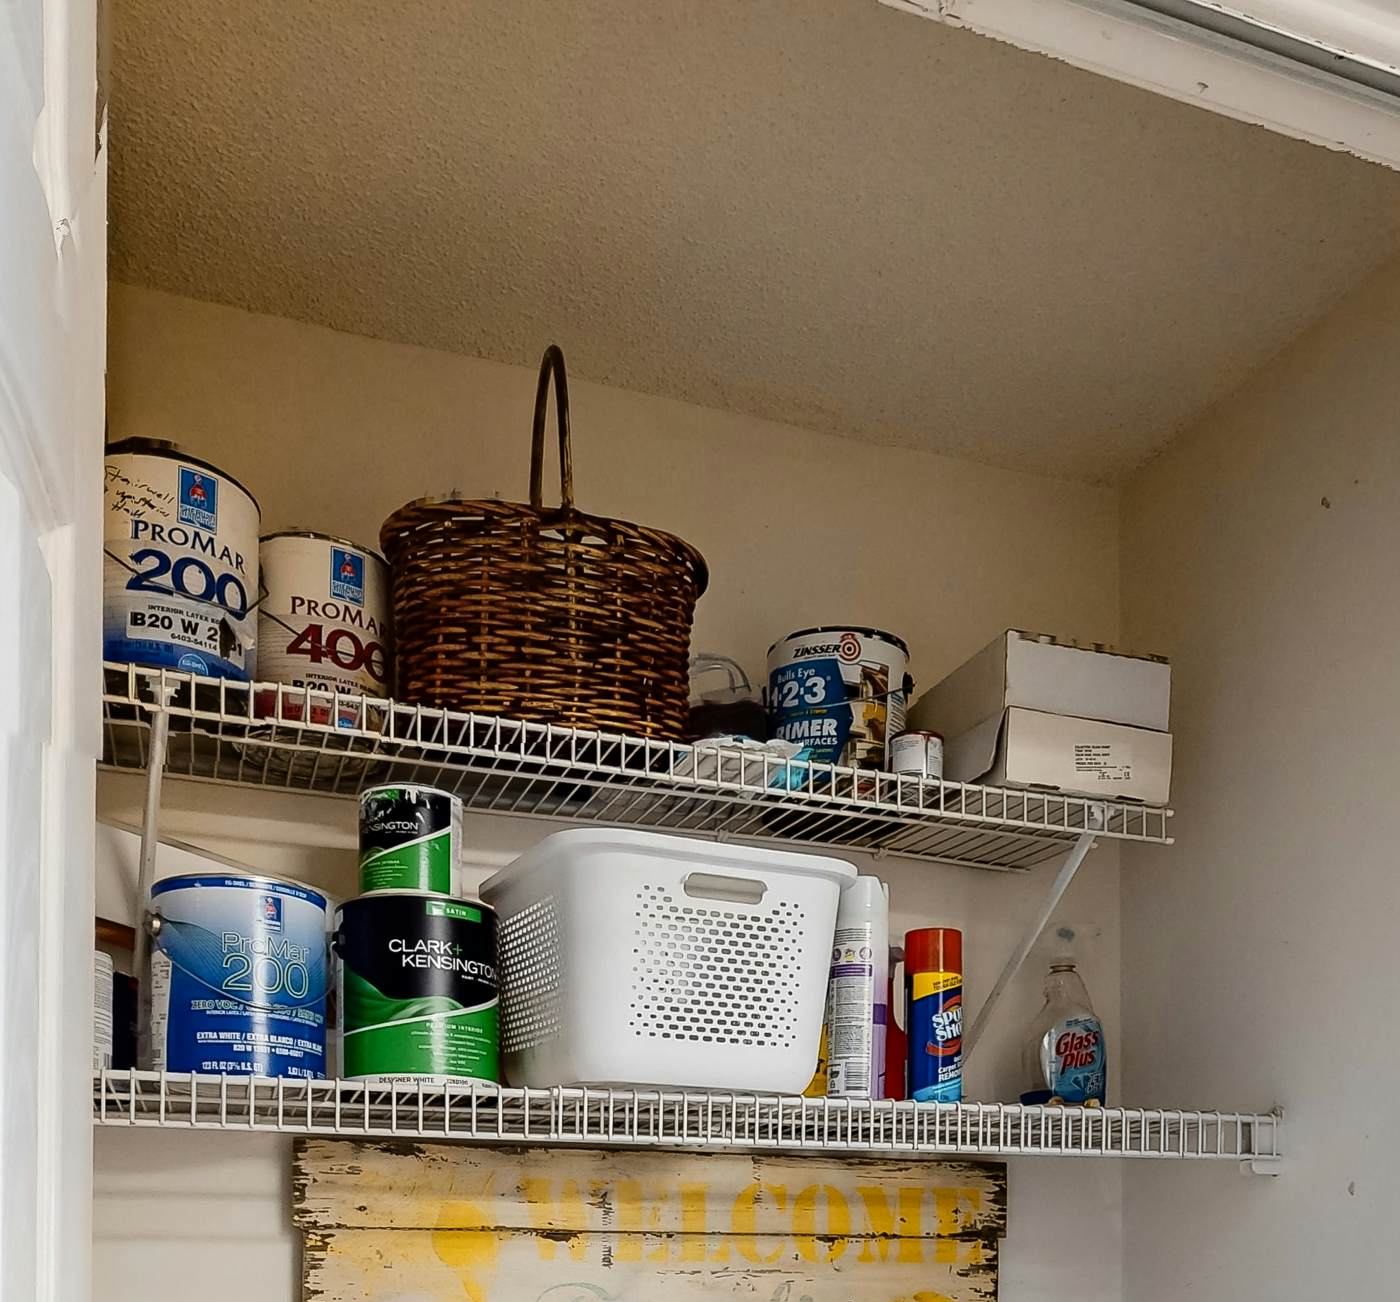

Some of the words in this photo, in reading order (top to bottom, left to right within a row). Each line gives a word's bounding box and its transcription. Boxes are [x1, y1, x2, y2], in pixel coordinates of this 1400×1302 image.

[130, 518, 246, 577] PROMAR
[126, 547, 247, 621] 200
[148, 604, 184, 616] INTERIOR
[130, 611, 173, 630] B20
[180, 618, 200, 636] W
[793, 644, 841, 658] ZINSSER
[797, 667, 816, 679] Eye
[776, 718, 838, 740] RIMER
[362, 820, 419, 833] SINGTON
[446, 907, 467, 916] SATIN
[221, 931, 310, 964] ProMar
[222, 952, 309, 999] 200
[402, 953, 497, 981] KENSINGTON
[219, 1032, 241, 1040] WHITE
[935, 1021, 962, 1042] SHO
[1055, 1031, 1100, 1057] Glass
[520, 1178, 981, 1265] WELCOME
